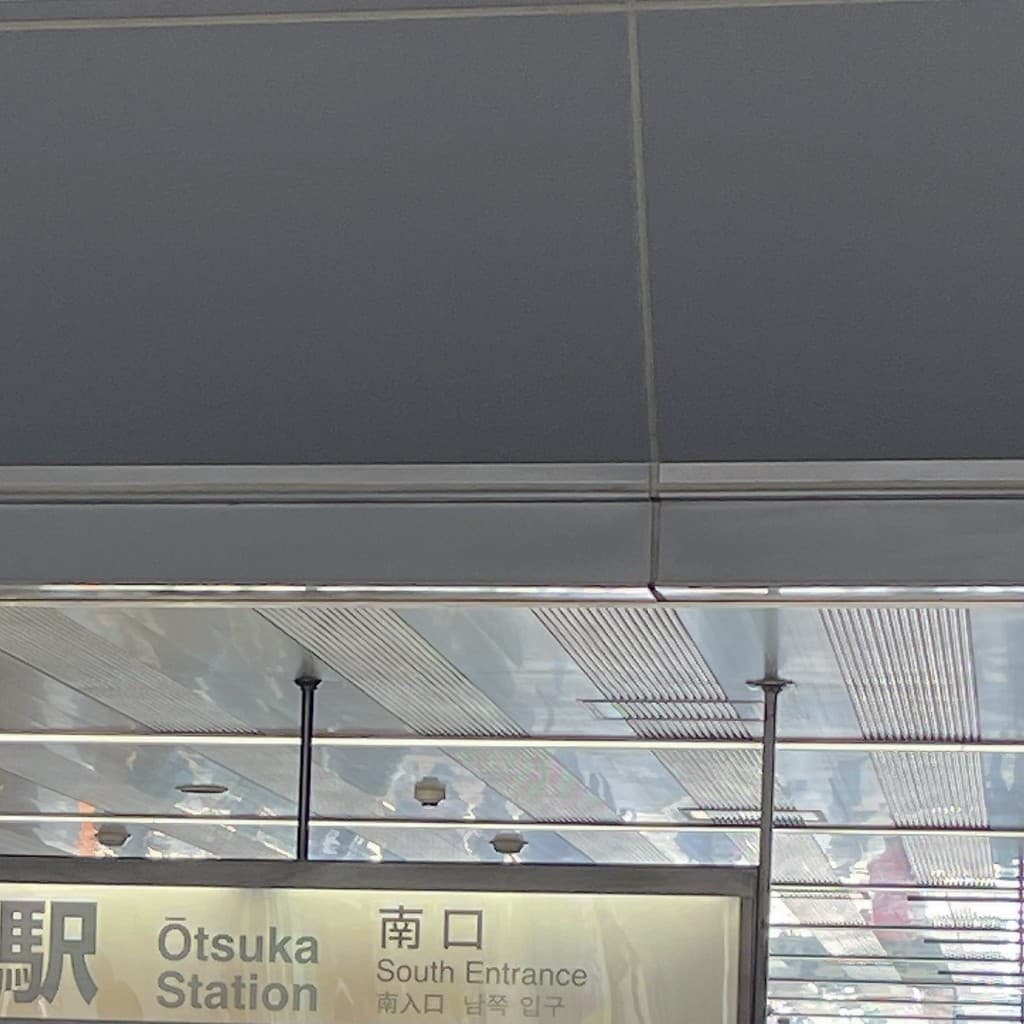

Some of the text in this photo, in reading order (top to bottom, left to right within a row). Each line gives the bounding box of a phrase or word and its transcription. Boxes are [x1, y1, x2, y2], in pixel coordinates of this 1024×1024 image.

[158, 916, 320, 964] Ōtsuka
[378, 907, 483, 950] 南口
[157, 969, 318, 1012] Station
[376, 957, 587, 987] South Entrance
[377, 991, 444, 1015] 南入口
